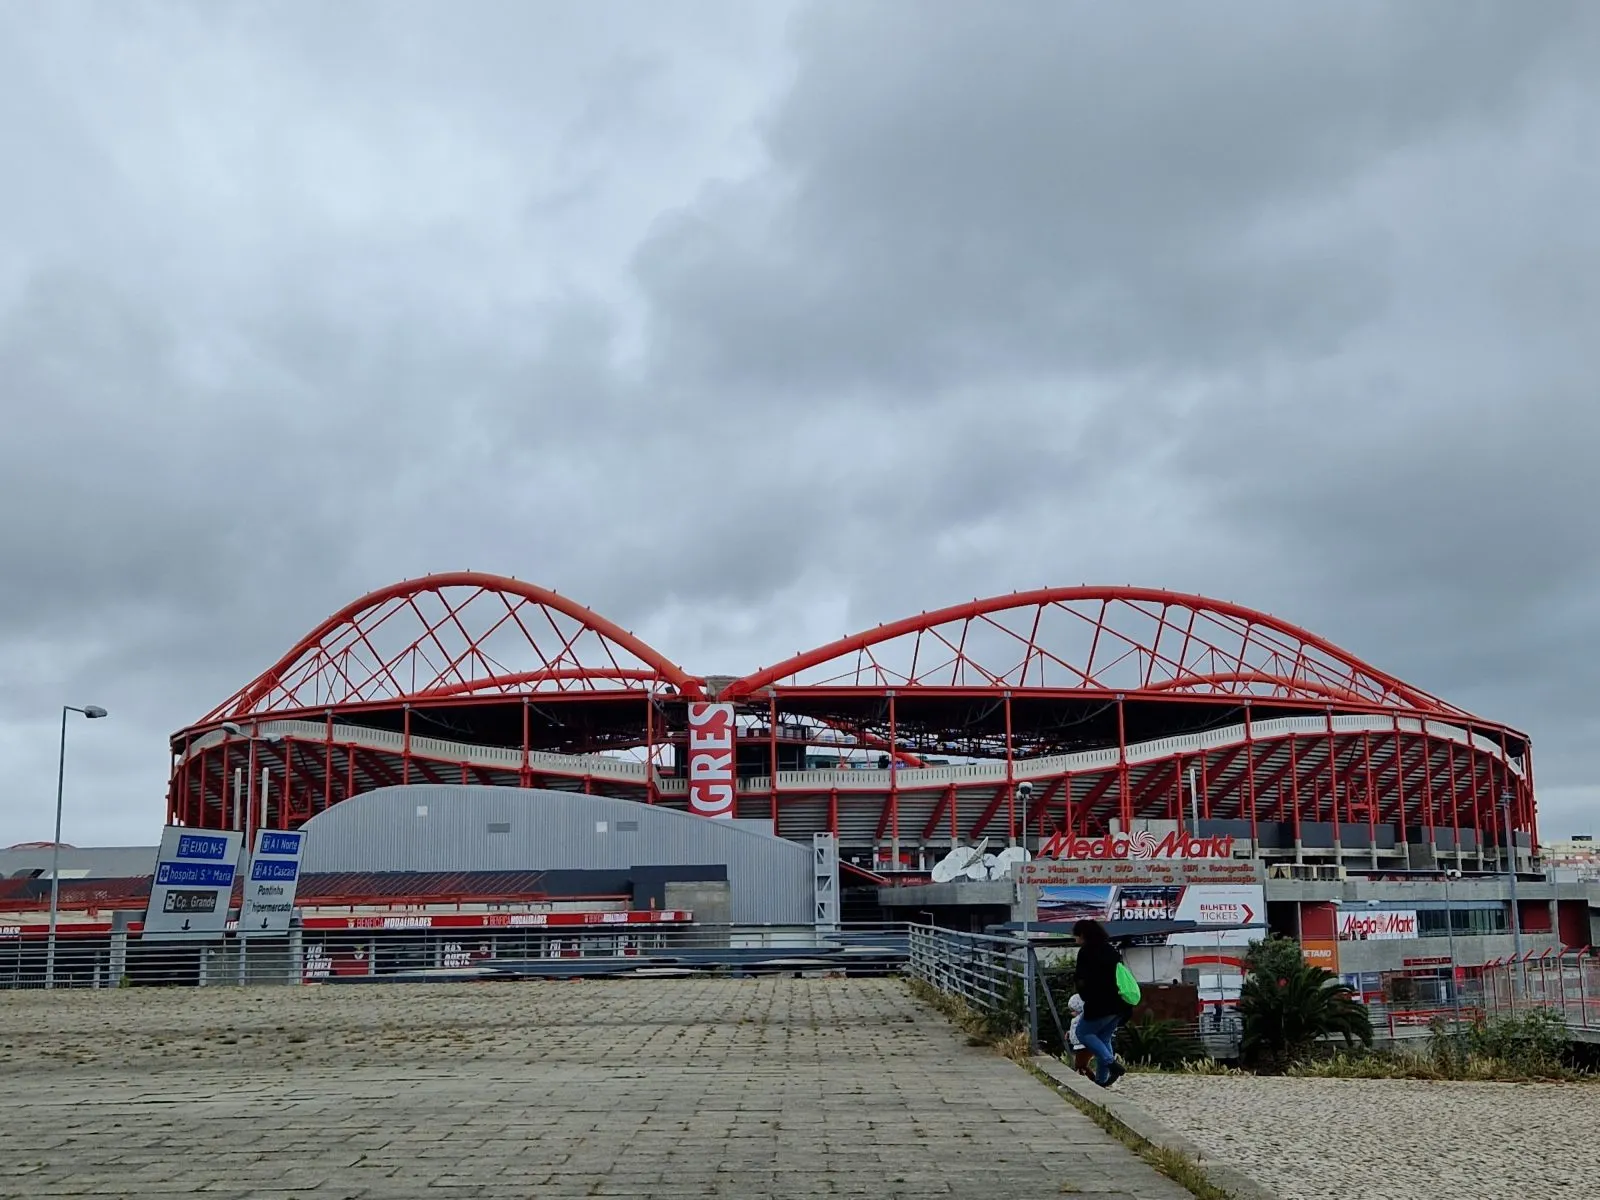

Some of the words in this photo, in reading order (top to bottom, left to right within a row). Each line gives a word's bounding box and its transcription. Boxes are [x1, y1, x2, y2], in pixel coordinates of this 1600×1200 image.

[688, 703, 734, 819] GRES
[190, 841, 208, 853] EIXO
[209, 843, 224, 854] N-S
[281, 839, 298, 850] Norte
[1036, 831, 1130, 859] Media
[1151, 831, 1235, 858] Markt
[170, 867, 198, 882] hospital
[213, 870, 231, 882] Maria
[273, 866, 296, 877] Cascais
[1091, 865, 1103, 873] TV
[257, 884, 284, 896] Pontinha
[190, 895, 216, 908] Grande
[251, 902, 292, 914] hipermercado
[1113, 908, 1176, 920] GORIOSO
[1201, 911, 1239, 920] TICKETS
[1343, 914, 1377, 934] Media
[1386, 913, 1415, 933] Markt
